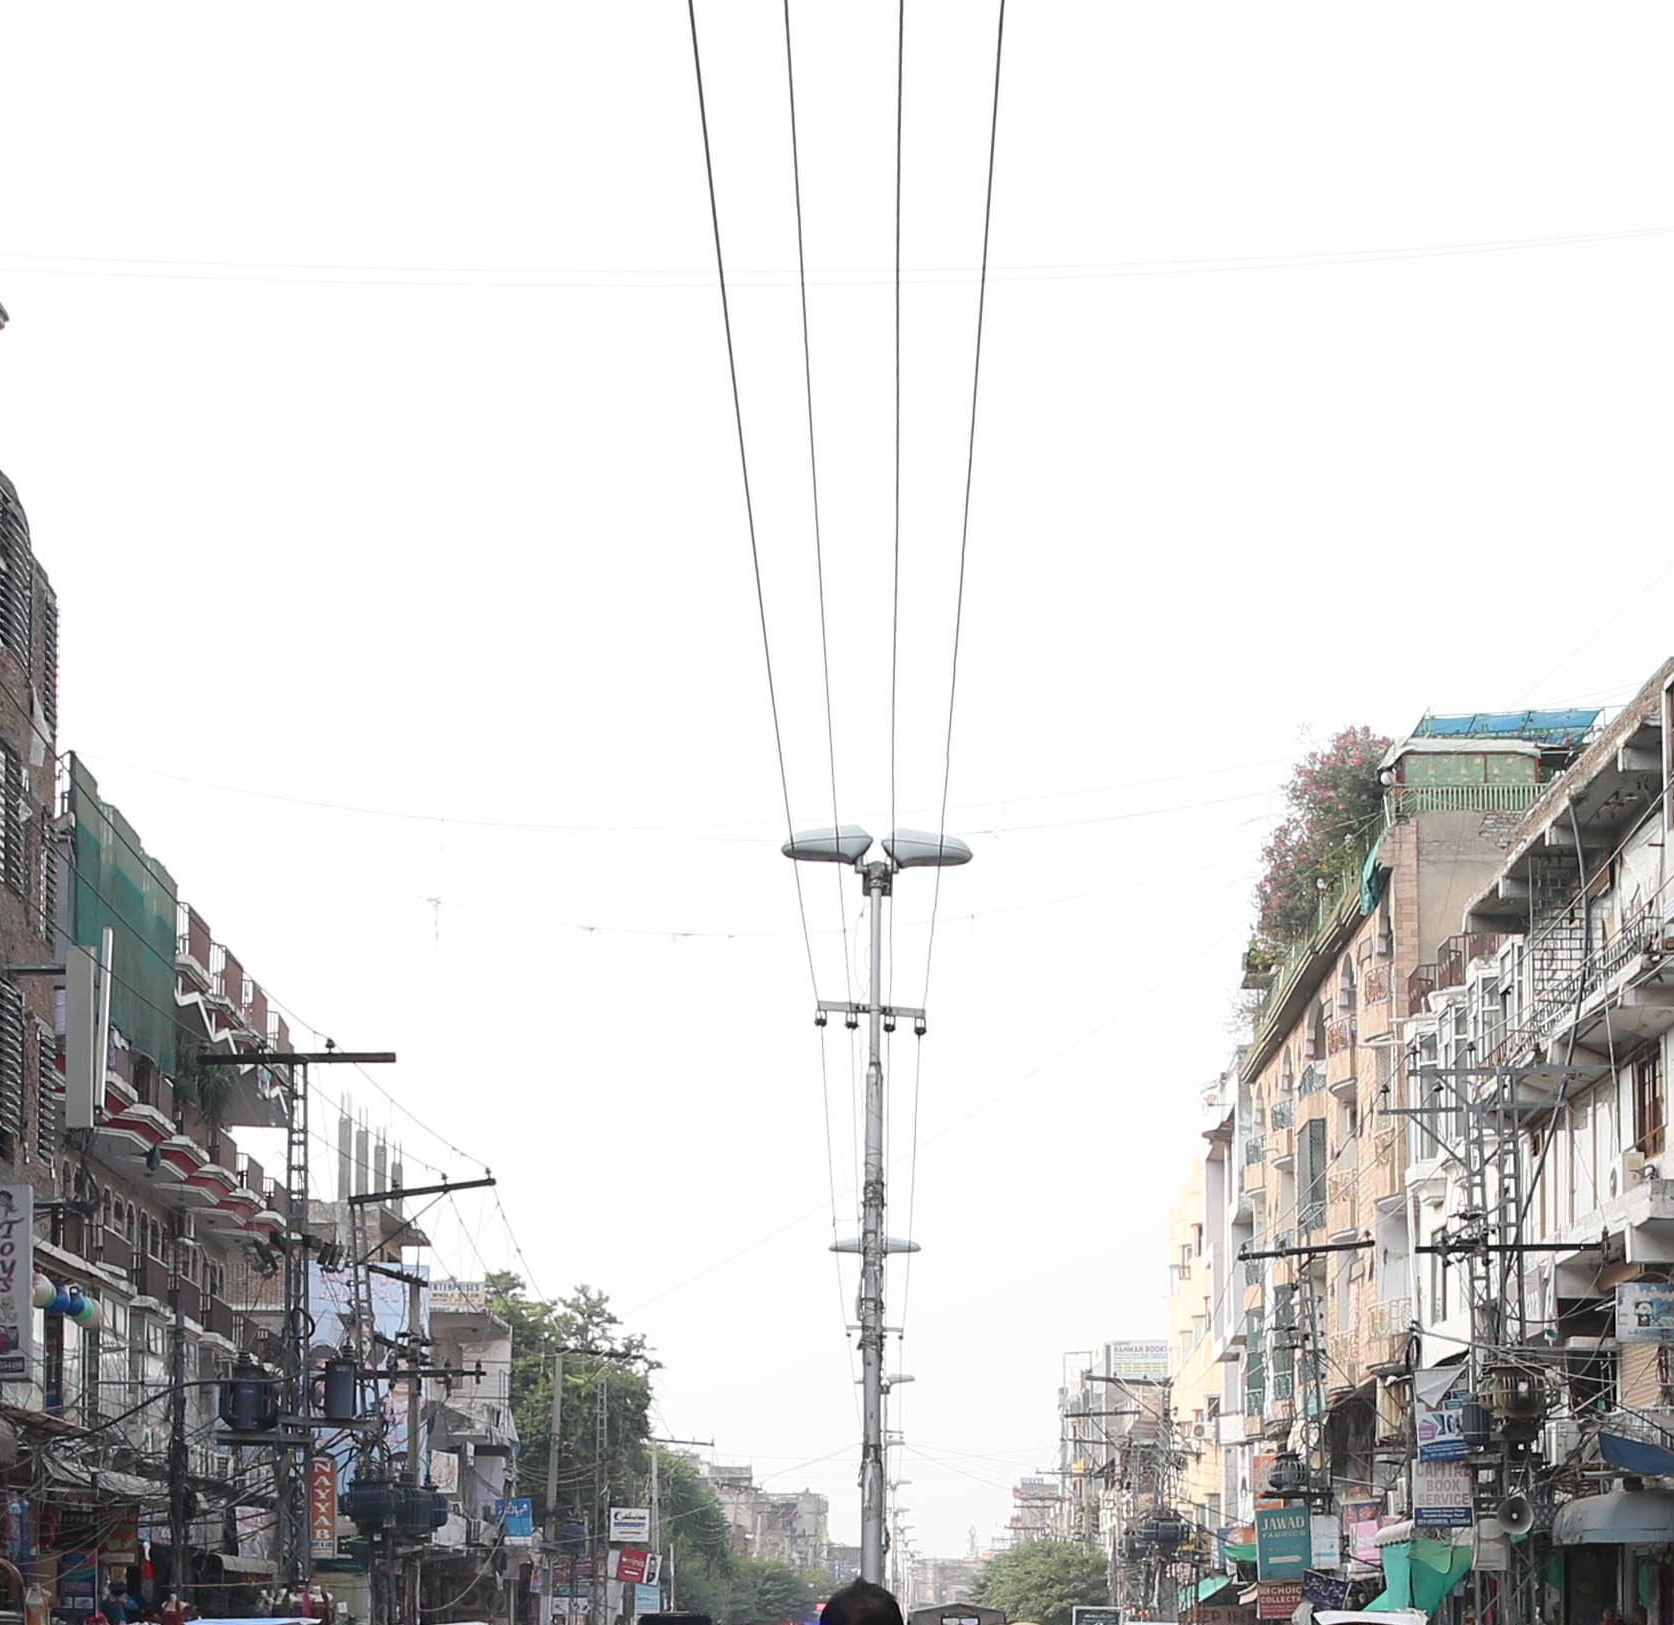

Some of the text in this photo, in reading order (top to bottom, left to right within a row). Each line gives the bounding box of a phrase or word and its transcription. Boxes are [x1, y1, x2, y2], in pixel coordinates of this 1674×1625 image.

[1426, 1480, 1461, 1492] BOOK
[313, 1461, 332, 1540] NAYYAB
[1418, 1493, 1470, 1506] SERVICE
[1261, 1515, 1305, 1531] JAWAD
